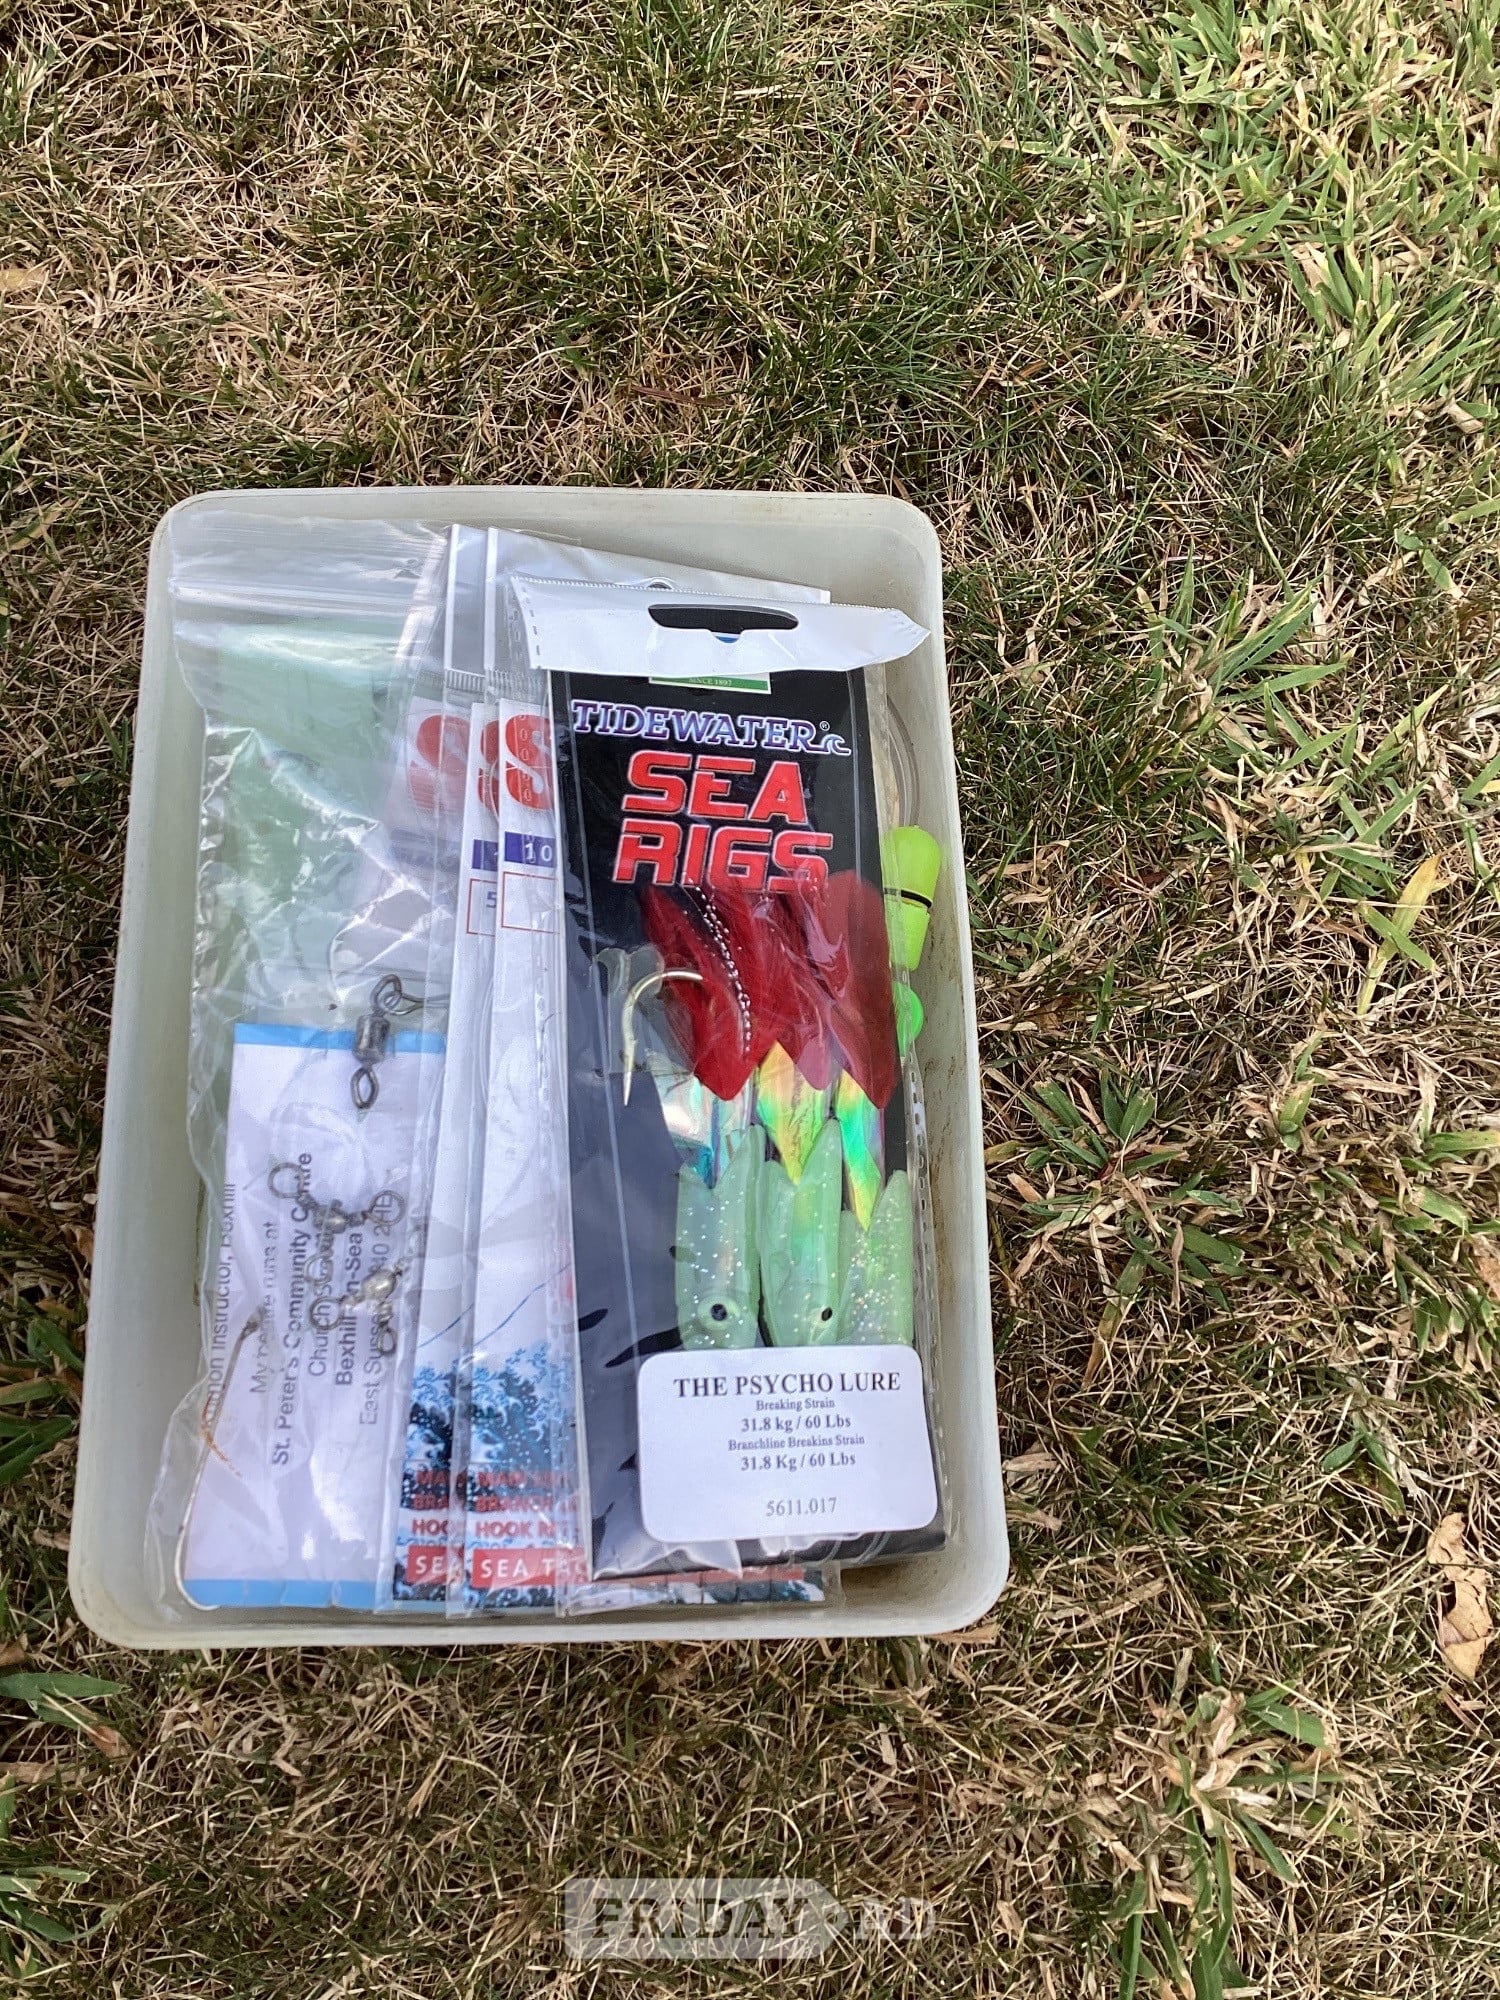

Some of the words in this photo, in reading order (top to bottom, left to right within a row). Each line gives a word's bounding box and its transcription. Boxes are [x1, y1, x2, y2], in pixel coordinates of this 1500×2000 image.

[620, 750, 807, 824] SEA
[612, 817, 833, 894] RIGS
[272, 1437, 291, 1465] St.
[283, 1229, 311, 1349] Community
[363, 1305, 388, 1375] Susse
[674, 1376, 728, 1398] THE
[734, 1373, 834, 1395] PSYCHO
[841, 1372, 901, 1392] LURE
[360, 1381, 380, 1424] East
[756, 1399, 803, 1412] Breaking
[805, 1398, 835, 1410] Strain
[741, 1418, 771, 1432] 31.8
[775, 1417, 793, 1433] kg
[805, 1416, 822, 1430] 60
[826, 1414, 851, 1428] Lbs
[728, 1437, 786, 1451] Branchline
[835, 1434, 865, 1446] Strain
[741, 1456, 771, 1471] 31.8
[775, 1455, 797, 1472] Kg
[809, 1453, 826, 1468] 60
[830, 1452, 856, 1467] Lbs
[766, 1497, 838, 1517] 5611.017
[475, 1520, 532, 1538] HOOK
[480, 1558, 529, 1578] SEA
